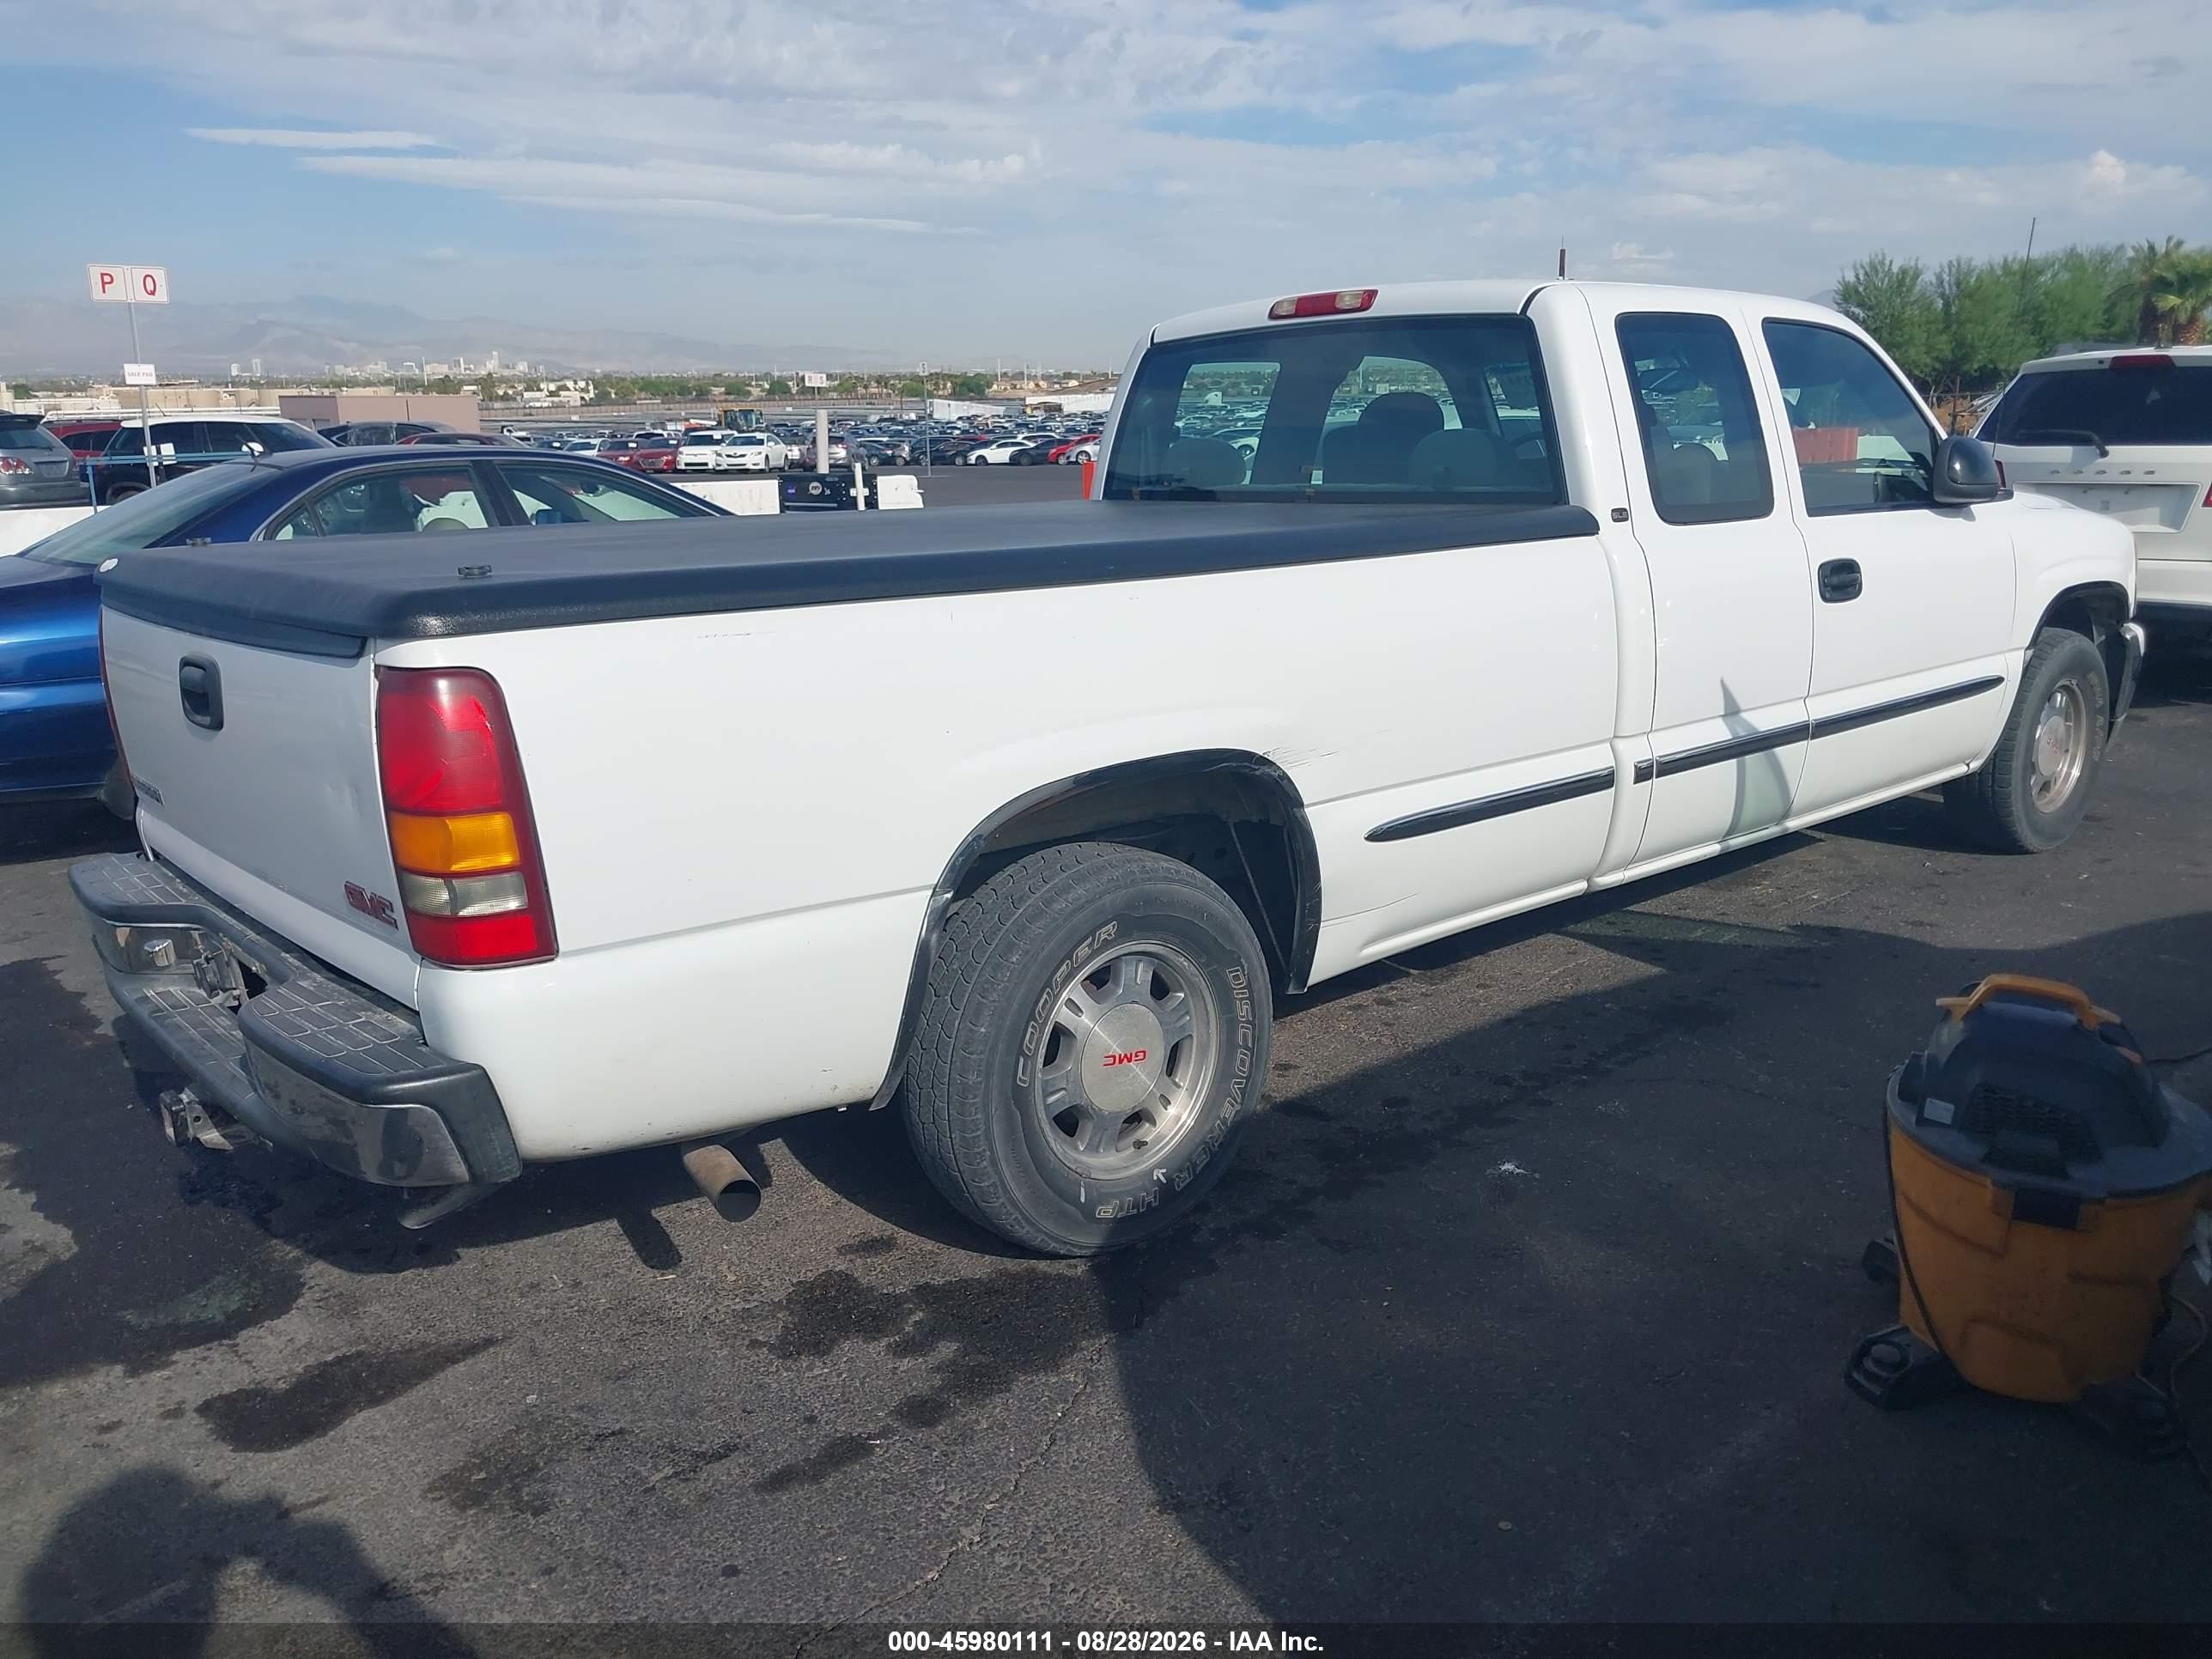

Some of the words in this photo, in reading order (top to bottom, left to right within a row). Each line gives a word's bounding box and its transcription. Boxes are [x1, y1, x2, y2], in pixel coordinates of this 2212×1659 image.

[100, 272, 114, 294] P
[143, 274, 157, 296] Q
[343, 880, 399, 931] GMC
[1017, 921, 1118, 1087] COOPER
[1103, 1049, 1147, 1067] GMC
[1175, 966, 1253, 1192] DISCOVERER
[1096, 1187, 1160, 1218] HTP
